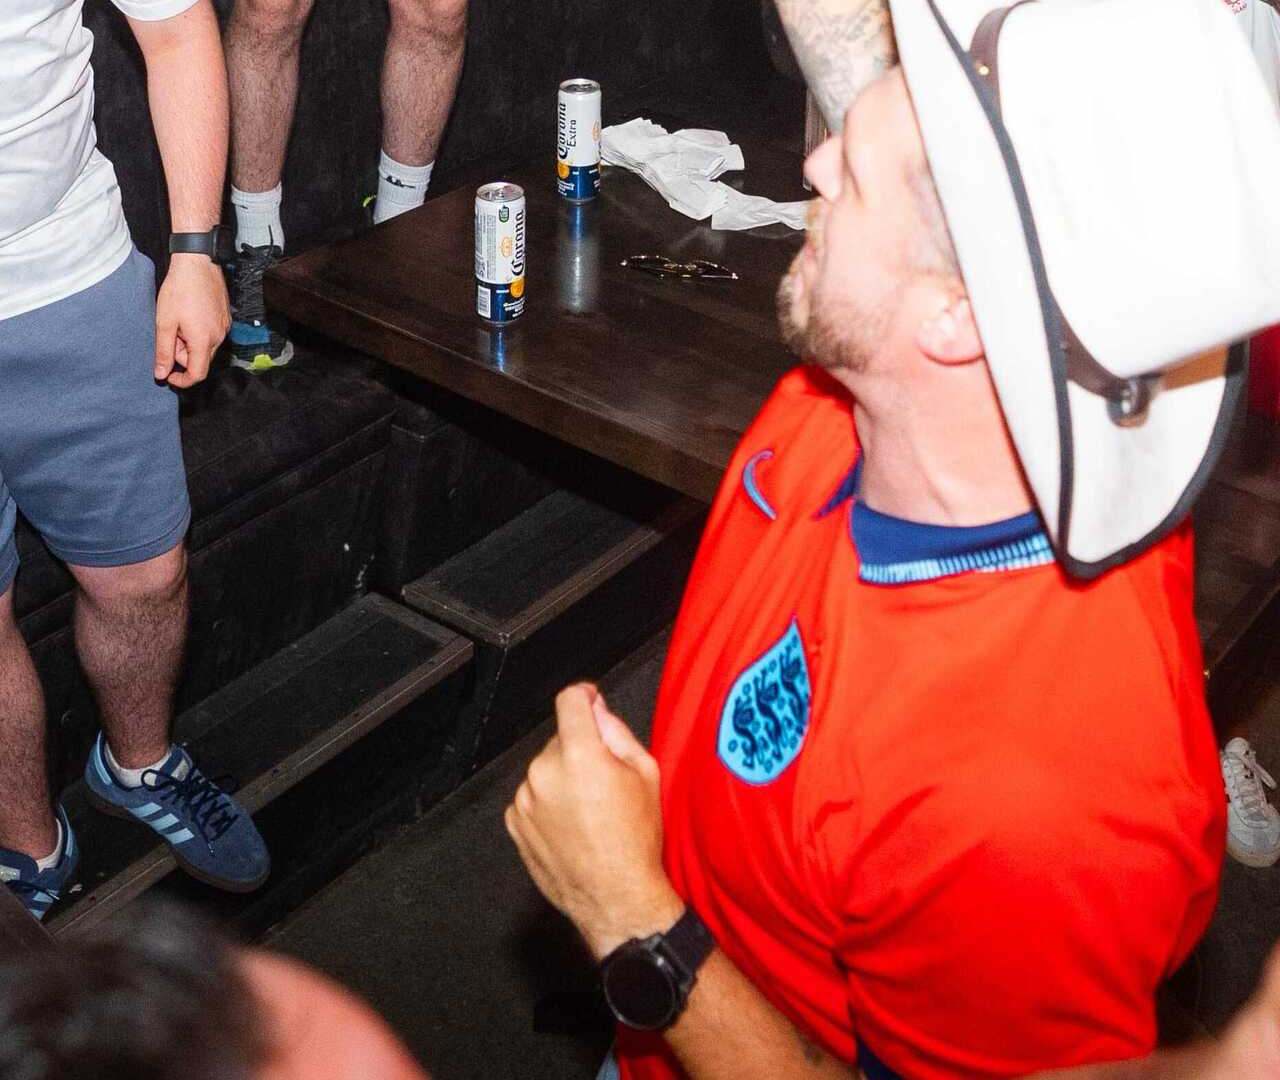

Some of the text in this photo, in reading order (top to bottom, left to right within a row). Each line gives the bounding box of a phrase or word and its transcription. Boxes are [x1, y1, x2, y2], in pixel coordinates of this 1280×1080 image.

[559, 102, 568, 160] Corona
[567, 120, 576, 148] Extra
[511, 209, 524, 276] Corona
